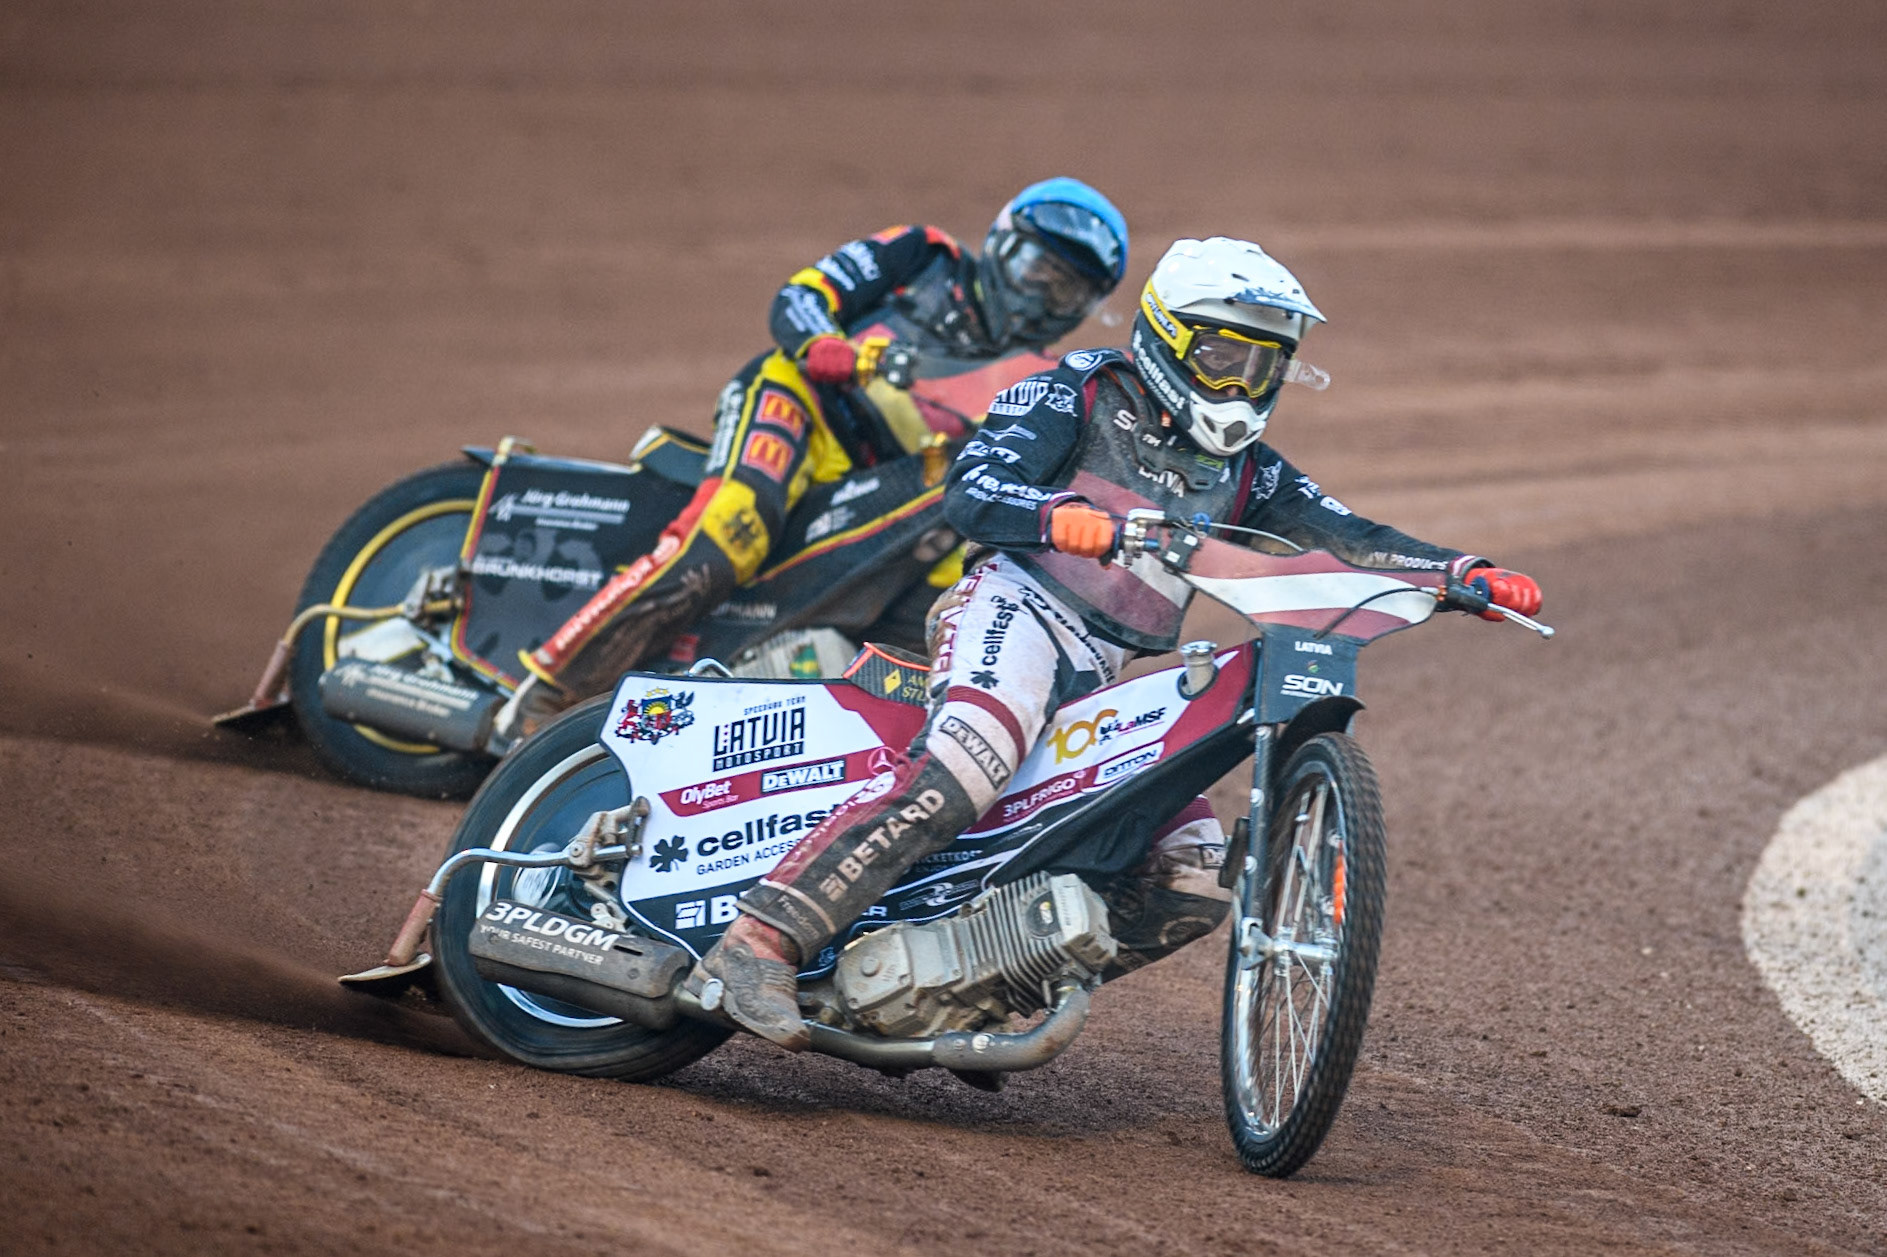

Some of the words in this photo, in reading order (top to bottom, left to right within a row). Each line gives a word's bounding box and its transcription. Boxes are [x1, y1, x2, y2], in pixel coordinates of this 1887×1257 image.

[1294, 641, 1334, 656] LATVIA
[1281, 674, 1344, 696] SON
[713, 706, 806, 757] LATVIA
[714, 743, 801, 771] MOTOSPORT
[1103, 749, 1158, 777] DITTON
[680, 780, 733, 806] OlyBet
[837, 788, 946, 883] BETARD
[696, 852, 750, 876] GARDEN
[485, 901, 620, 952] 3PLDGM
[480, 924, 511, 941] YOUR
[511, 932, 552, 952] SAFEST
[552, 944, 604, 966] PARTNER
